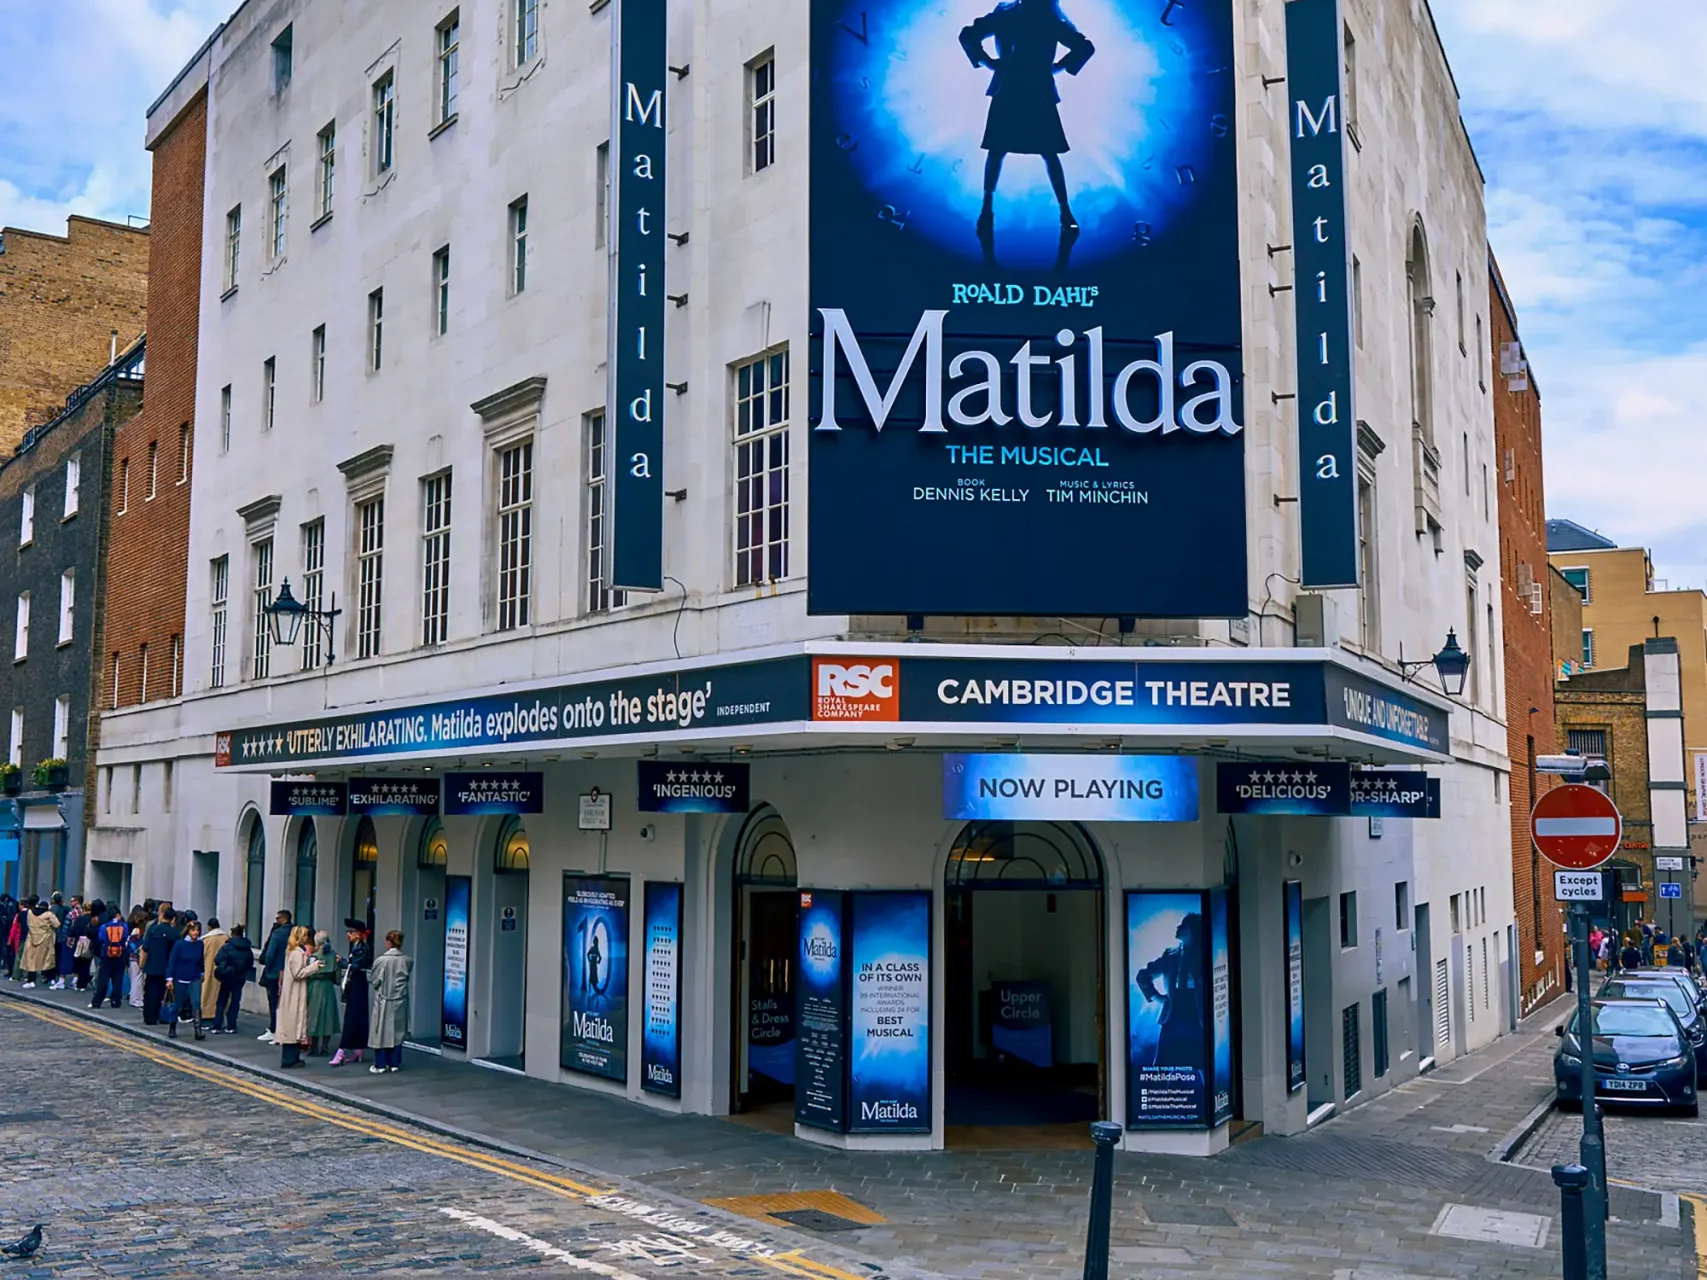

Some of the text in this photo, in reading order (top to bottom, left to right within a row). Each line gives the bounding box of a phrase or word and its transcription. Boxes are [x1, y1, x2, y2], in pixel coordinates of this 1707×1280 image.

[624, 81, 663, 478] Matilda
[952, 283, 1024, 305] ROALD
[1296, 94, 1339, 480] Matilda
[814, 307, 1243, 436] Matilda
[945, 445, 1109, 467] THE MUSICAL
[957, 478, 986, 487] BOOK
[1059, 480, 1135, 490] MUSIC & LYRICS
[913, 487, 1030, 502] DENNIS KELLY
[1046, 489, 1149, 504] TIM MINCHIN
[818, 664, 893, 698] RSC
[937, 679, 1291, 707] CAMBRIDGE THEATRE
[716, 701, 771, 716] INDEPENDENT
[817, 710, 863, 718] COMPANY
[1372, 698, 1385, 729] AND
[336, 715, 427, 751] EXHILARATING.
[431, 708, 482, 742] Matilda
[486, 700, 558, 741] explodes
[563, 696, 604, 730] onto
[609, 690, 642, 726] the
[647, 681, 712, 727] stage’
[653, 784, 736, 798] ‘INGENIOUS’
[980, 778, 1163, 800] NOW PLAYING
[1236, 785, 1331, 799] ‘DELICIOUS’
[289, 797, 339, 806] ‘SUBLIME’
[350, 794, 438, 805] ‘EXHILARATING’
[458, 791, 530, 802] ‘FANTASTIC’
[1560, 875, 1598, 886] Except
[1561, 887, 1596, 897] cycles
[804, 937, 837, 959] Matilda
[861, 963, 920, 972] IN A CLASS
[859, 973, 922, 982] OF ITS OWN
[1001, 989, 1042, 1005] Upper
[751, 999, 778, 1010] Stalls
[762, 1013, 789, 1024] Dress
[1001, 1005, 1040, 1019] Circle
[573, 1010, 614, 1043] Matilda
[877, 1016, 903, 1025] BEST
[751, 1026, 780, 1038] Circle
[866, 1029, 914, 1037] MUSICAL
[648, 1063, 673, 1084] Matilda
[1140, 1073, 1196, 1081] #MatildaPose
[861, 1101, 918, 1120] Matilda
